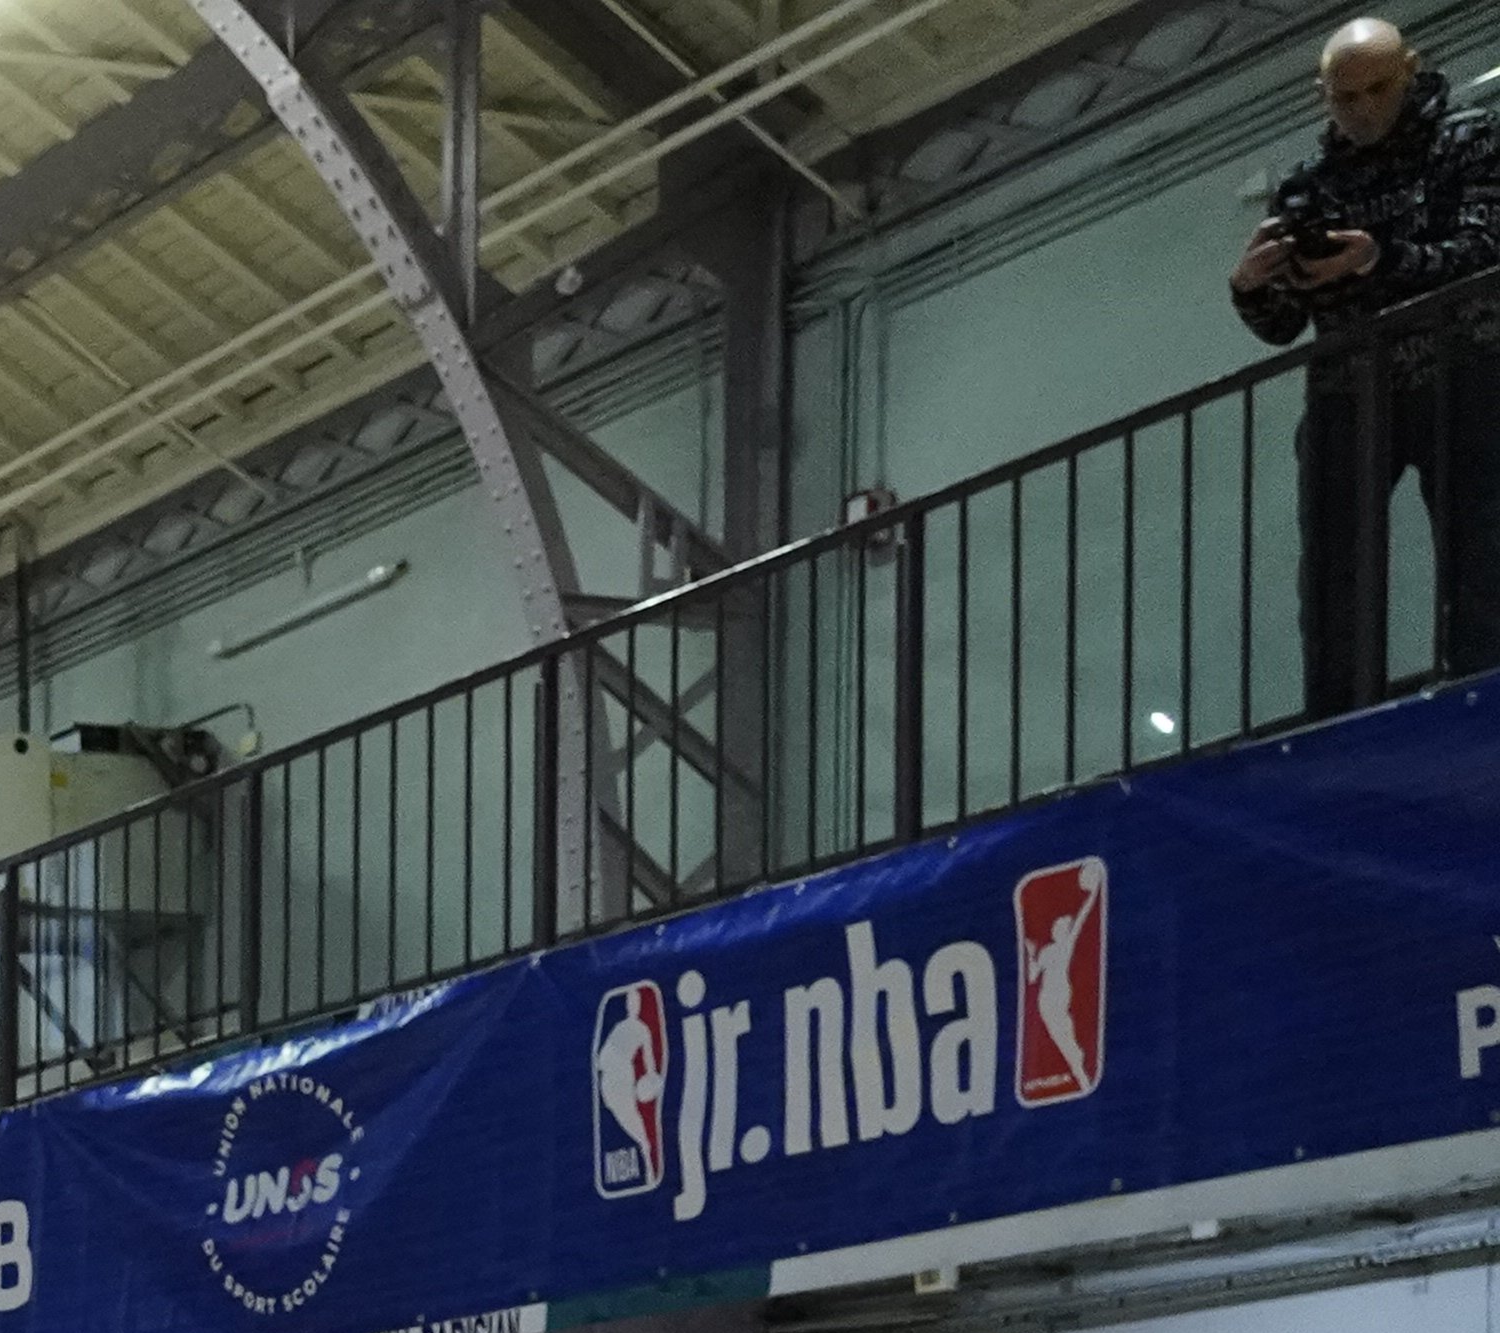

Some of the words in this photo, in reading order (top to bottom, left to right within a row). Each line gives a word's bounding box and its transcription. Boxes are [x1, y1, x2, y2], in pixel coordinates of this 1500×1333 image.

[213, 1097, 247, 1177] UNION
[249, 1072, 365, 1144] NATIONALE
[673, 920, 998, 1222] jr.nba
[202, 1238, 224, 1272] DU
[223, 1274, 276, 1316] SPORT
[282, 1208, 350, 1312] SCOLAIRE
